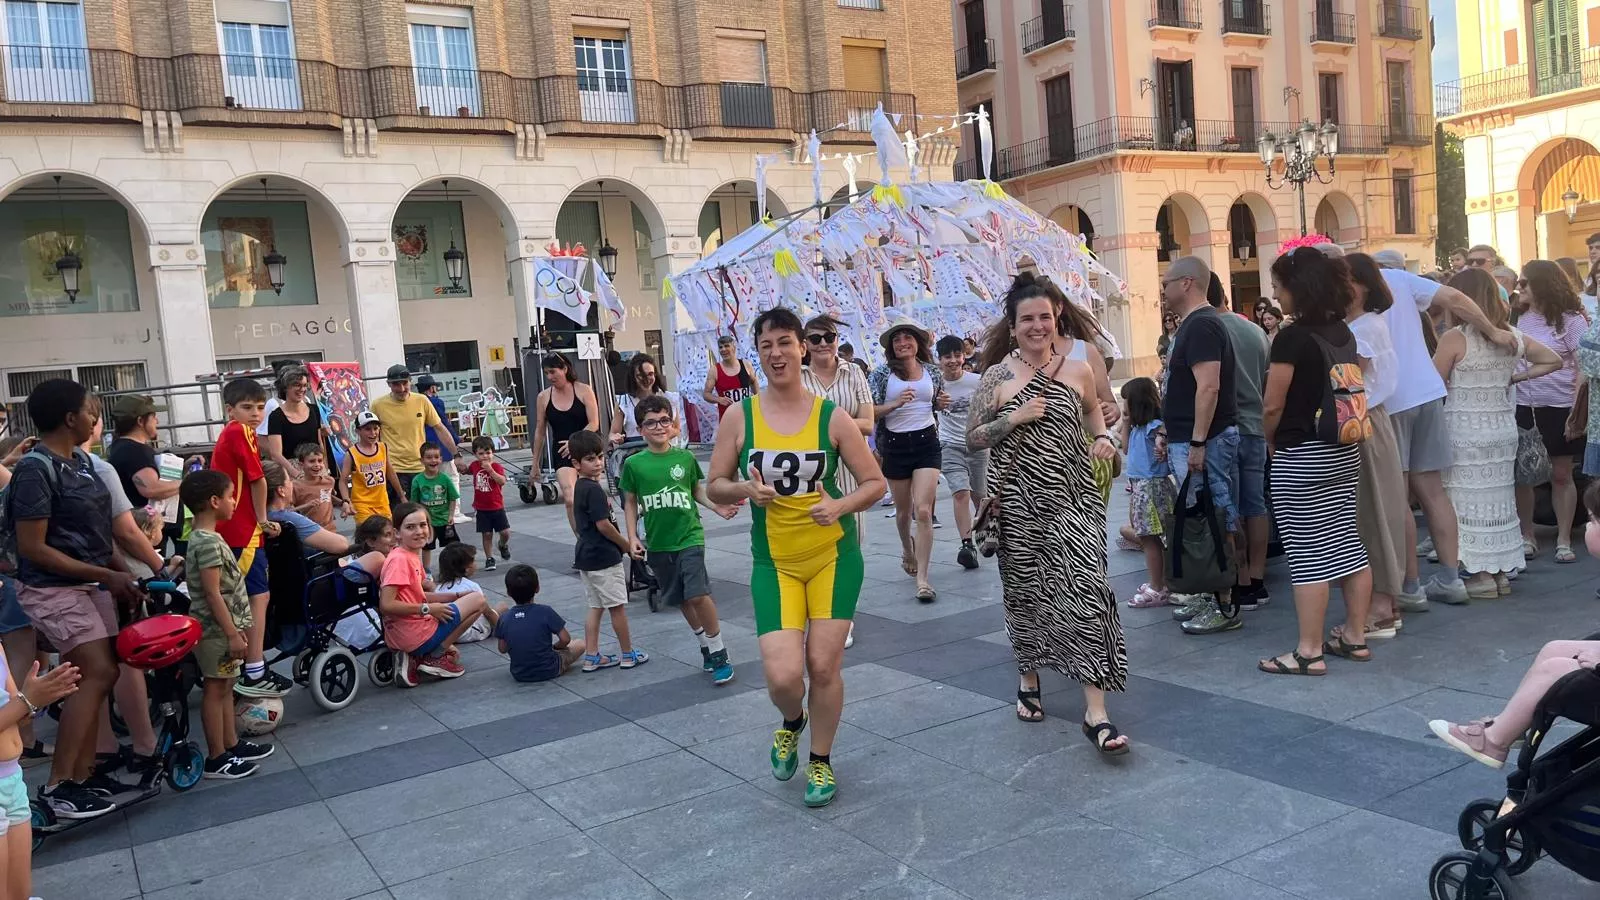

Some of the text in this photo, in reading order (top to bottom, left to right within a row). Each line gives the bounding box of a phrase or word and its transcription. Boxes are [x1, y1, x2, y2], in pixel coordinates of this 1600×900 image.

[365, 470, 385, 486] 23
[749, 451, 825, 496] 137
[643, 488, 691, 512] PEÑAS
